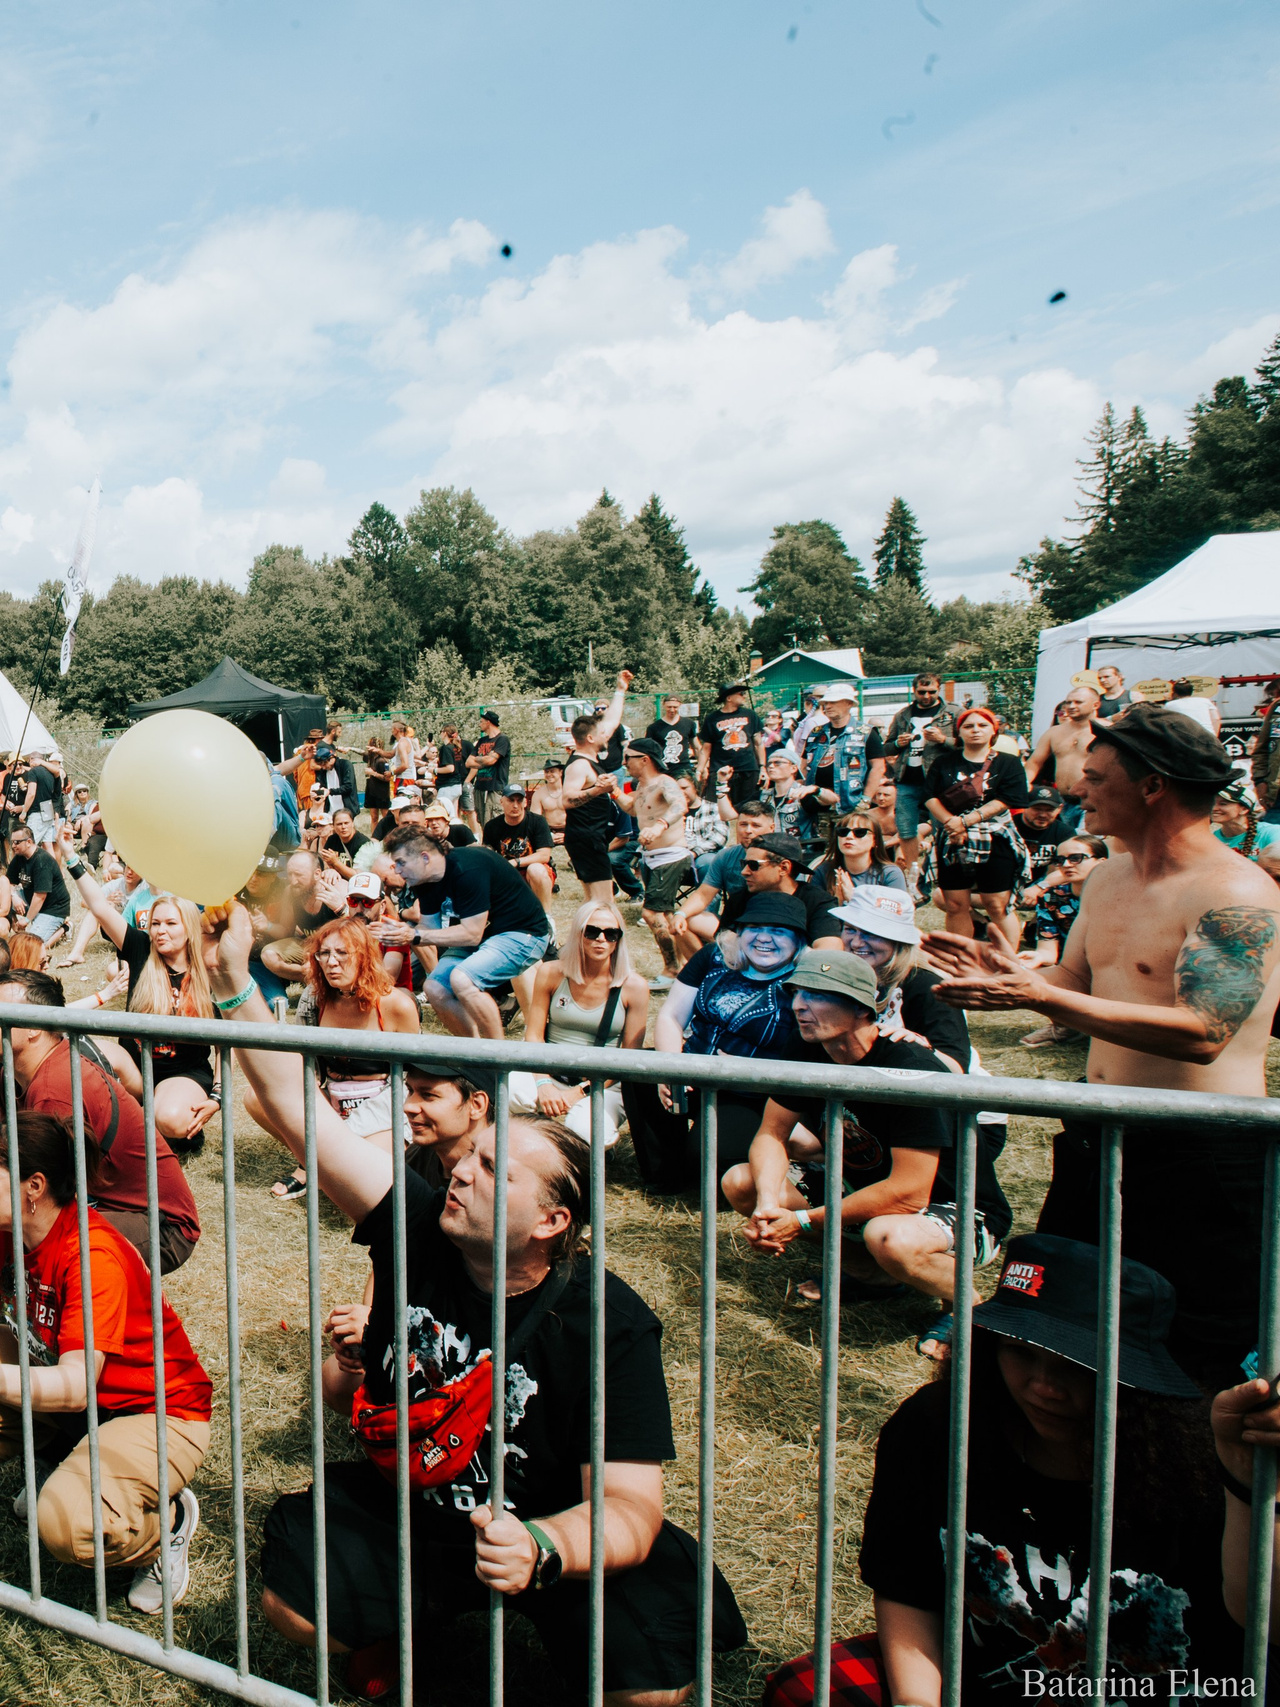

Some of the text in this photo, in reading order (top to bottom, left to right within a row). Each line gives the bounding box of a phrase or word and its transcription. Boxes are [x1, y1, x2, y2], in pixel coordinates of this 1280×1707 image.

[1006, 1264, 1039, 1279] ANTI-
[1002, 1275, 1031, 1290] PARTY
[426, 1451, 445, 1469] PARTY
